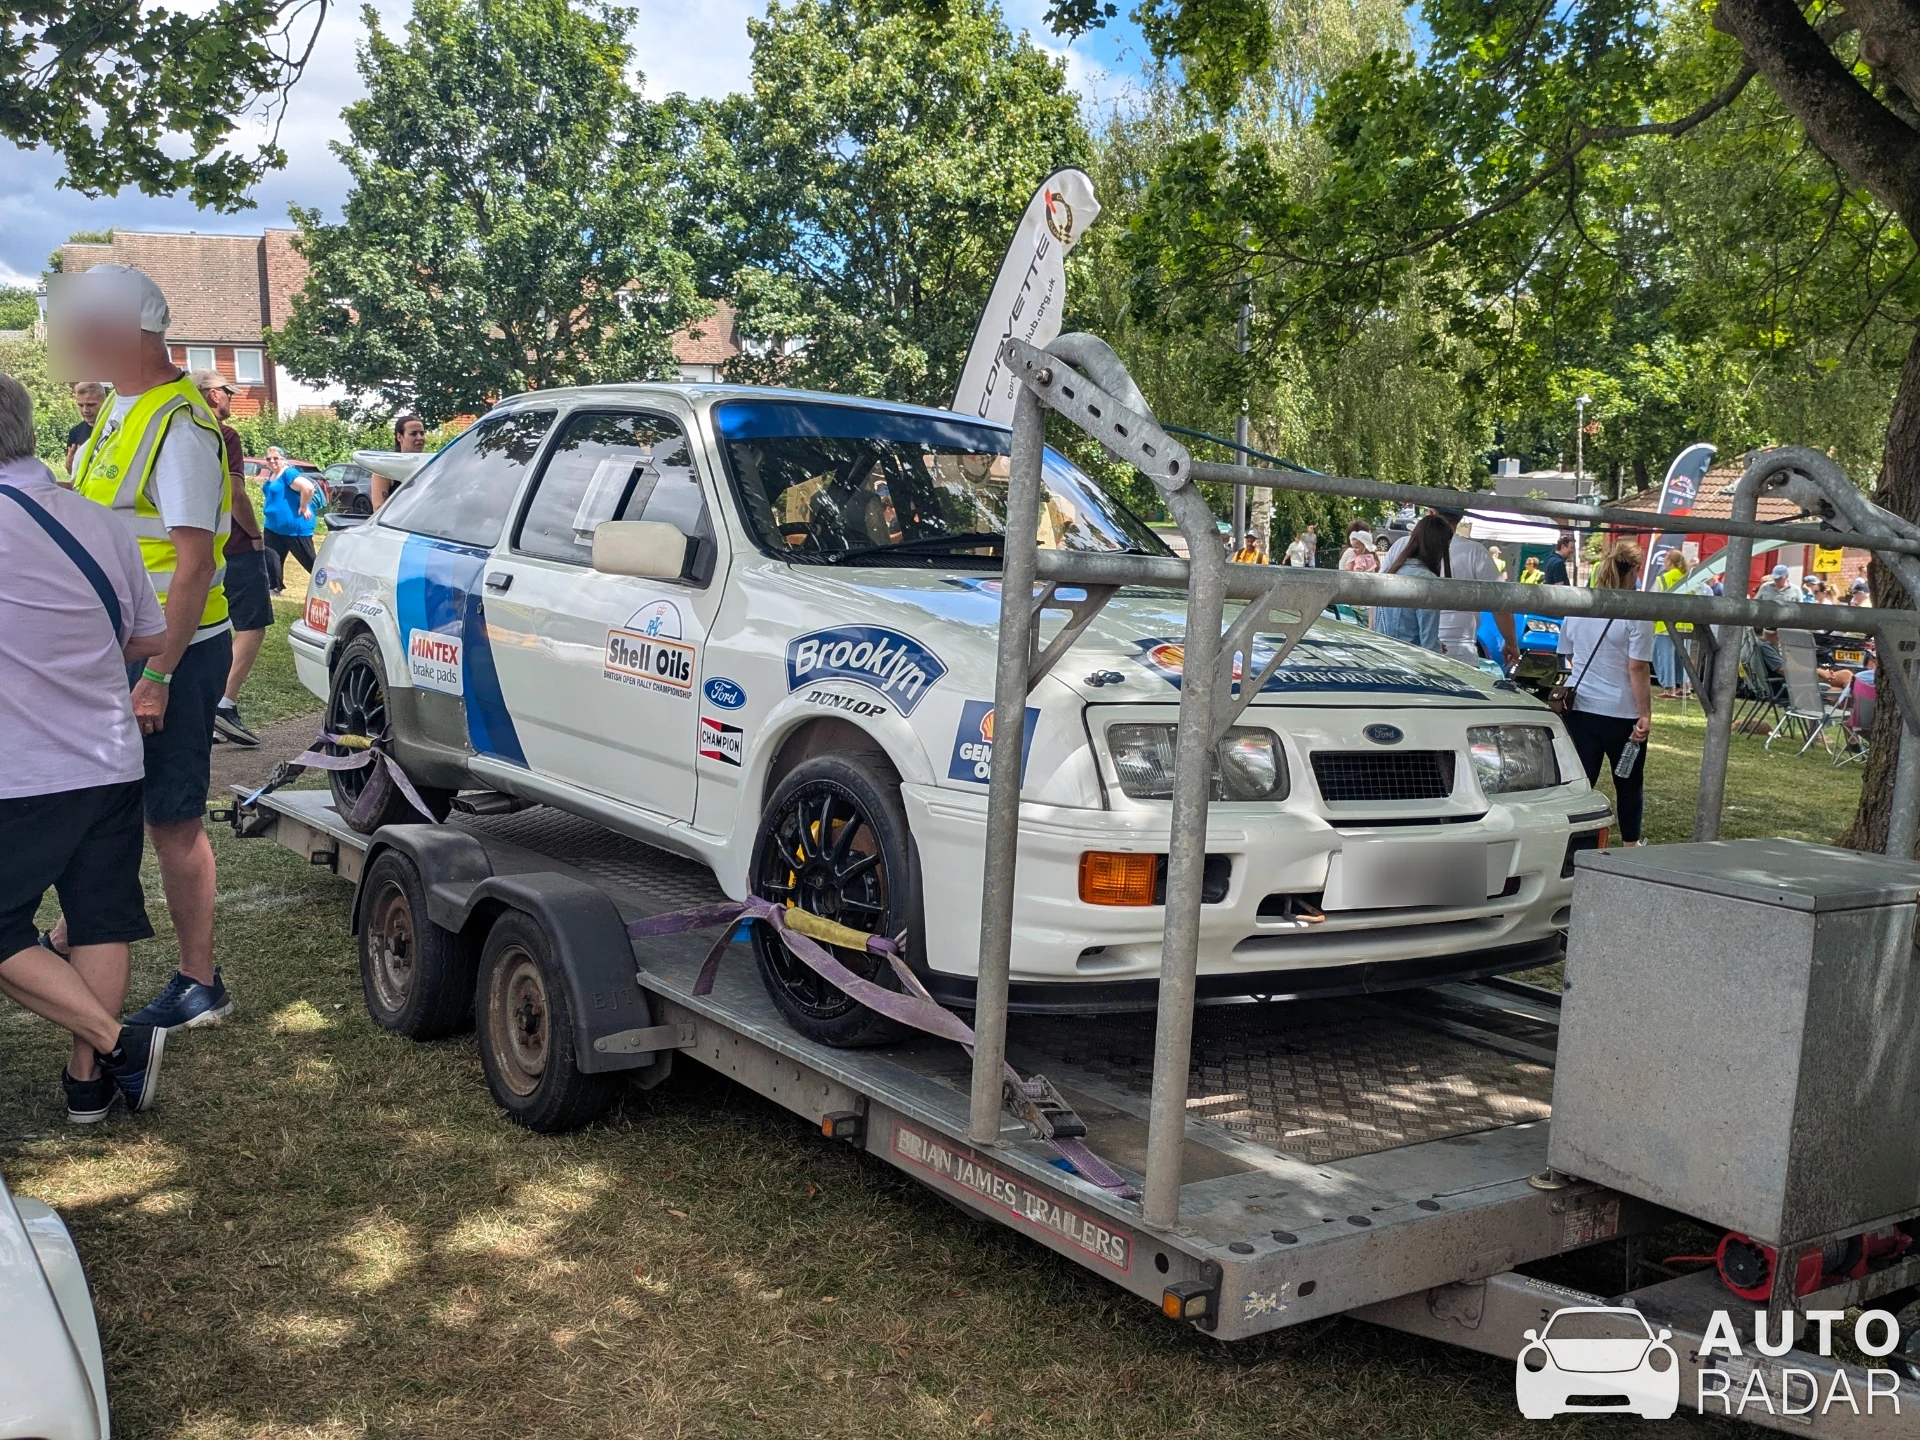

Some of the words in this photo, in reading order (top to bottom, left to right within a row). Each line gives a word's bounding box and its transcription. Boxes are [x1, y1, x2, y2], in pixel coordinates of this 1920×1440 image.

[978, 233, 1050, 419] CORVETTE
[349, 602, 384, 617] DUNLOP
[411, 636, 459, 665] MINTEX
[608, 638, 652, 671] Shell
[656, 648, 690, 681] Oils
[413, 660, 435, 679] brake
[436, 668, 457, 684] pads
[795, 637, 926, 701] Brooklyn
[1275, 671, 1433, 688] PERFORMANCE
[603, 670, 622, 682] BRITISH
[622, 675, 636, 686] OPEN
[636, 678, 652, 690] RALLY
[652, 682, 693, 700] CHAMPIONSHIP
[711, 681, 738, 705] Ford
[805, 690, 887, 718] DUNLOP
[702, 730, 740, 753] CHAMPION
[898, 1127, 953, 1173] BRIAN
[954, 1158, 1016, 1205] JAMES
[1023, 1191, 1124, 1261] TRAILERS
